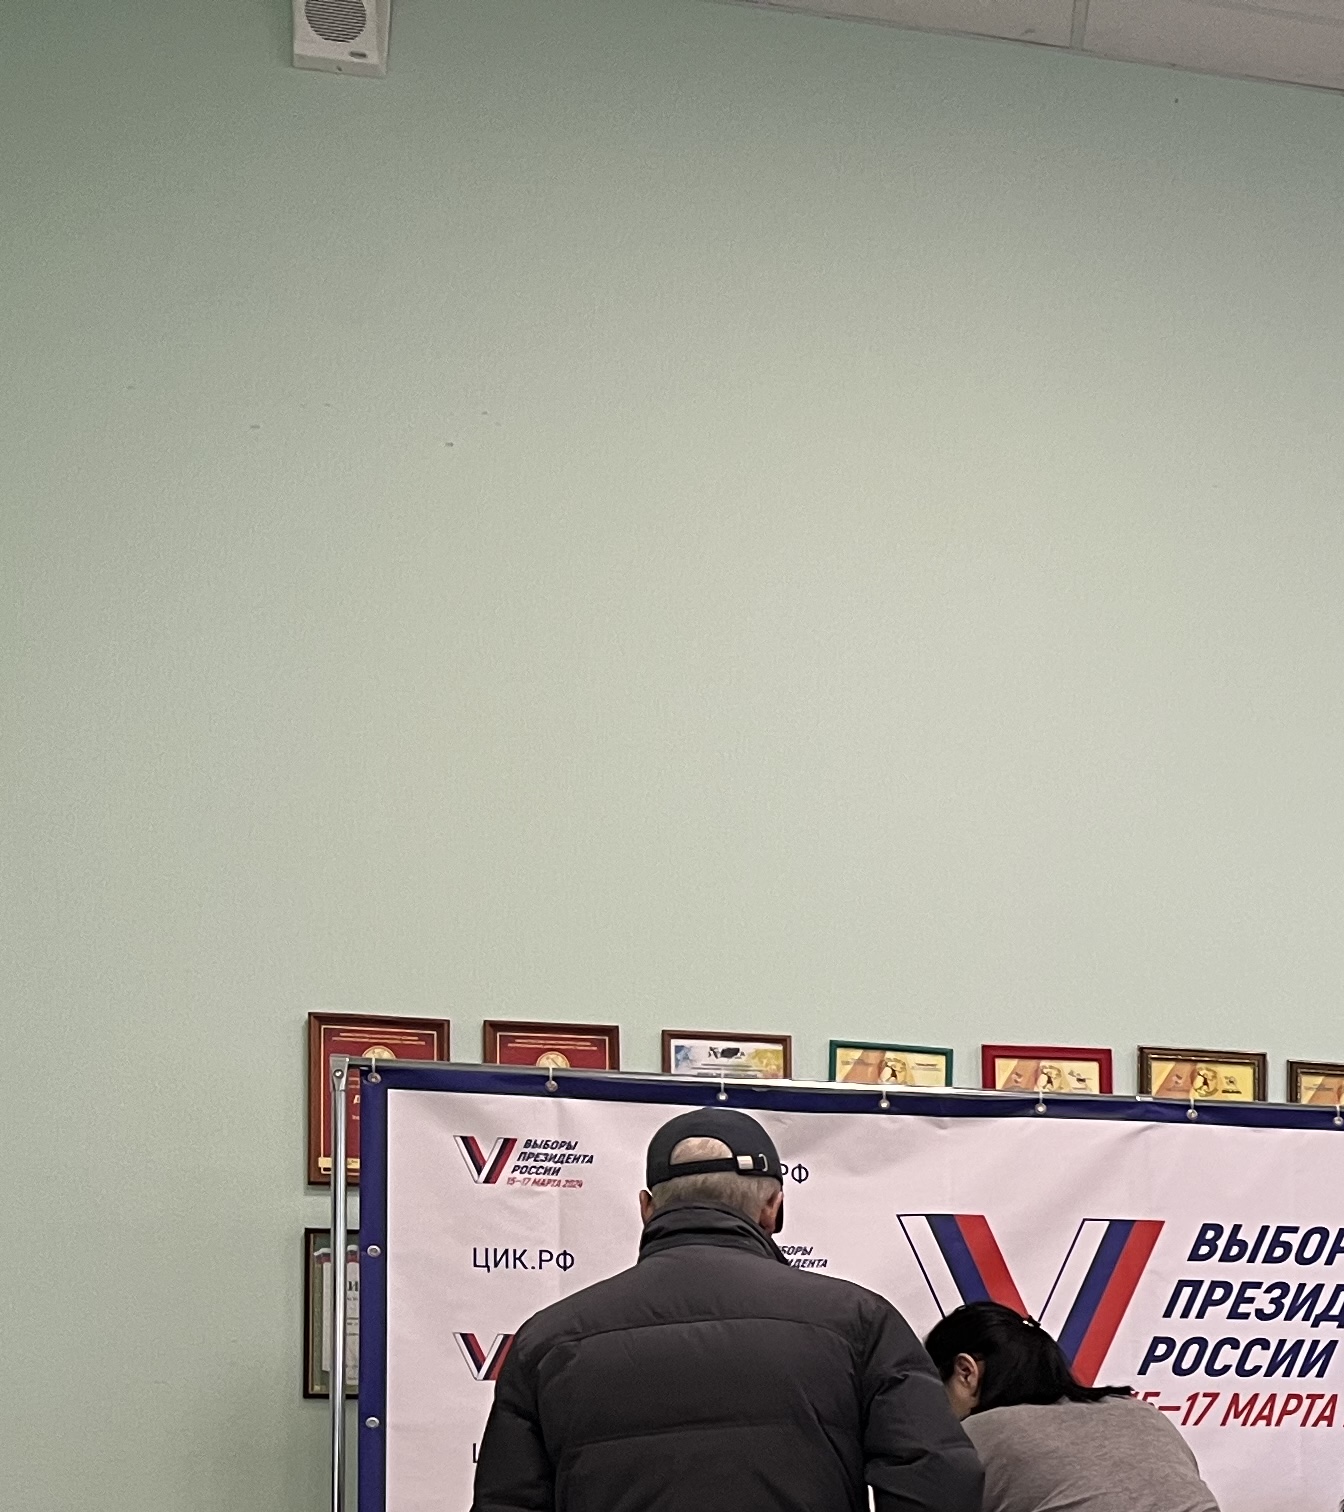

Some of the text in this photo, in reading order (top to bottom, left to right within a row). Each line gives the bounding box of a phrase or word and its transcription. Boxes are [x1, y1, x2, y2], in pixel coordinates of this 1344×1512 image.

[523, 1139, 578, 1151] ВЫБОРЫ
[517, 1152, 595, 1165] ПРЕЗИДЕНТА
[511, 1165, 562, 1176] РОССИИ
[472, 1247, 575, 1273] ЦИК.РФ
[1137, 1335, 1339, 1378] РОССИИ
[1220, 1392, 1336, 1427] МАРТА
